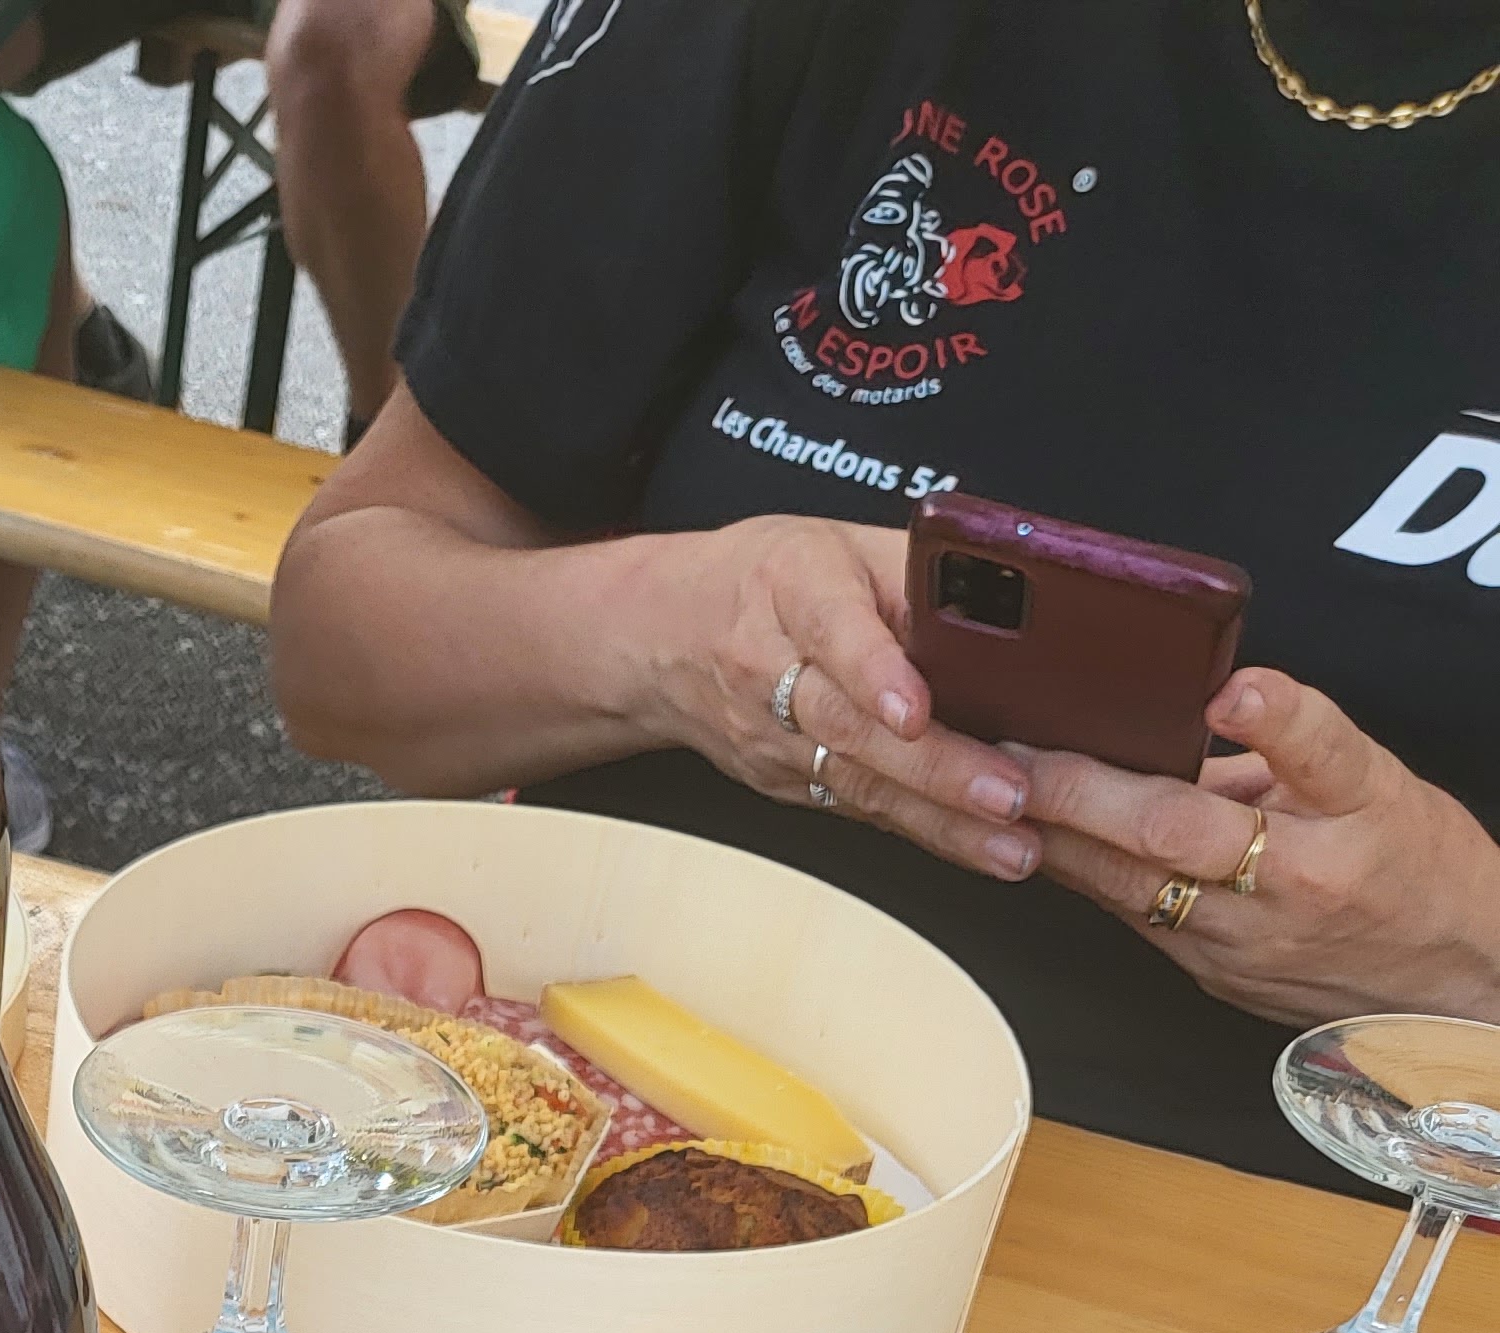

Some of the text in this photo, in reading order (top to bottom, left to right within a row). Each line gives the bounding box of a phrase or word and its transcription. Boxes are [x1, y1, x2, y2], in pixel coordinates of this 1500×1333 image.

[973, 136, 1068, 243] ROSE
[815, 325, 989, 381] ESPOIR
[850, 377, 943, 405] motards
[711, 397, 749, 441] Les
[748, 415, 904, 492] Chardons
